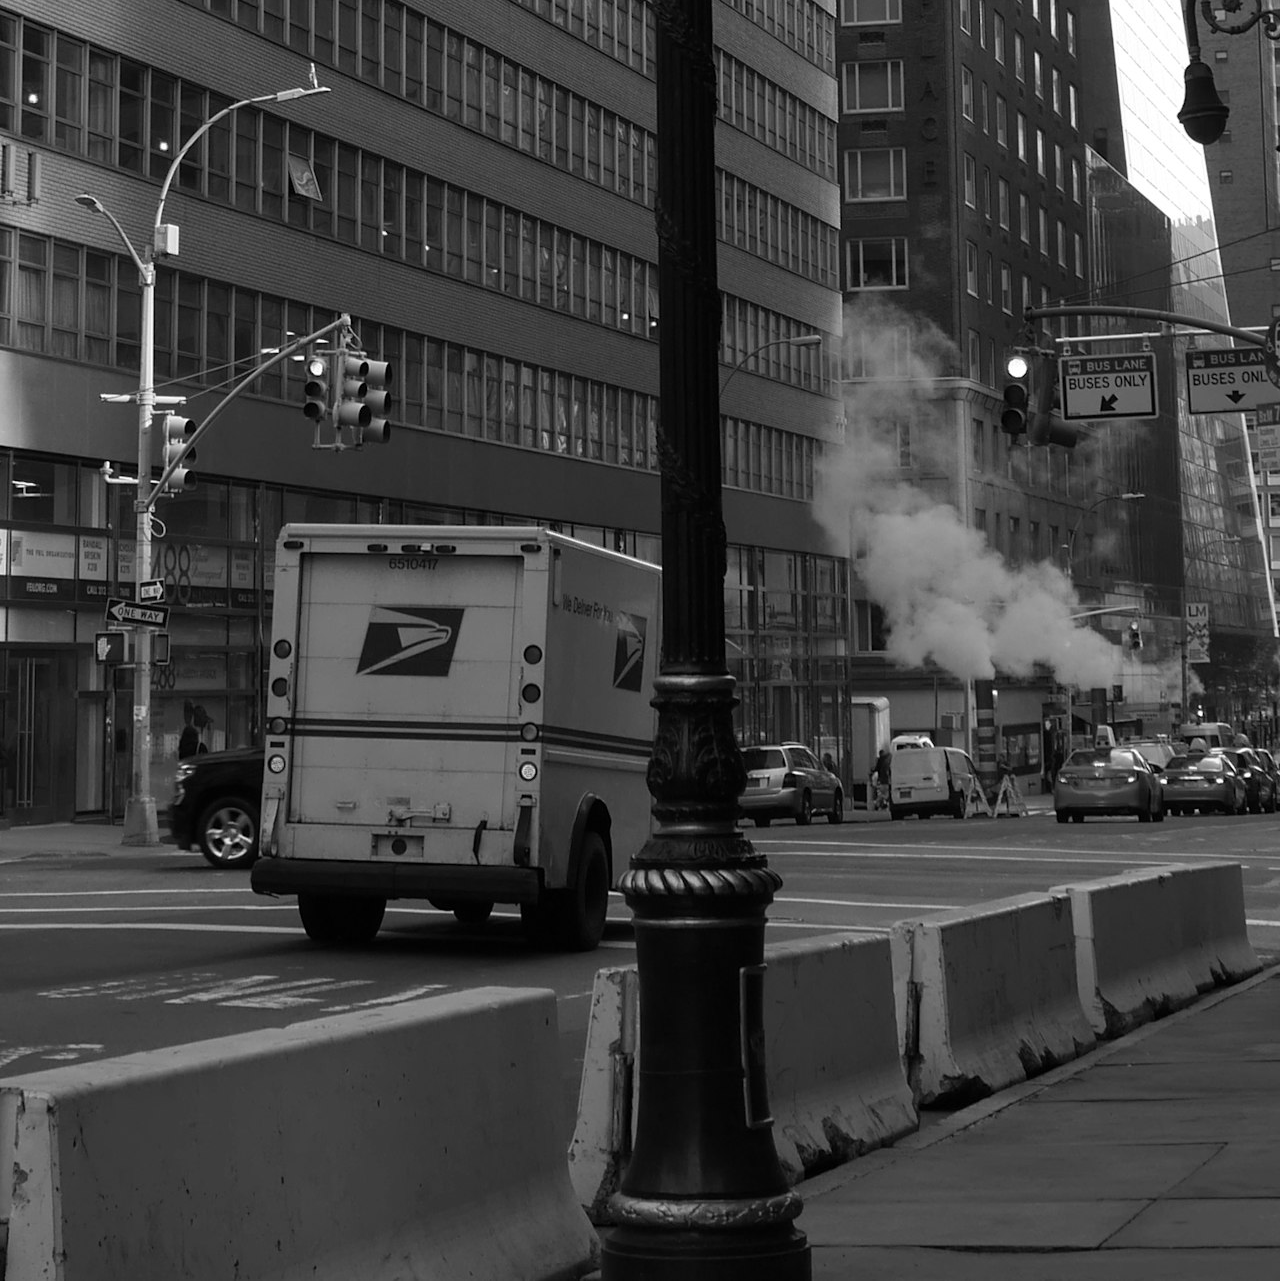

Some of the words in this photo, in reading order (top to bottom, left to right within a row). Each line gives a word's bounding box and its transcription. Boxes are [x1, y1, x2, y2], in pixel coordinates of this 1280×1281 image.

[1210, 353, 1236, 365] BUS
[1240, 352, 1265, 363] LAN
[1087, 361, 1110, 372] BUS
[1114, 359, 1147, 371] LANE
[1069, 376, 1110, 390] BUSES
[1114, 374, 1147, 388] ONLY
[1192, 372, 1236, 386] BUSES
[1241, 370, 1268, 384] ONL
[389, 558, 439, 570] 6510417
[117, 607, 137, 618] ONE
[140, 611, 160, 621] WAY
[1189, 606, 1206, 617] LM
